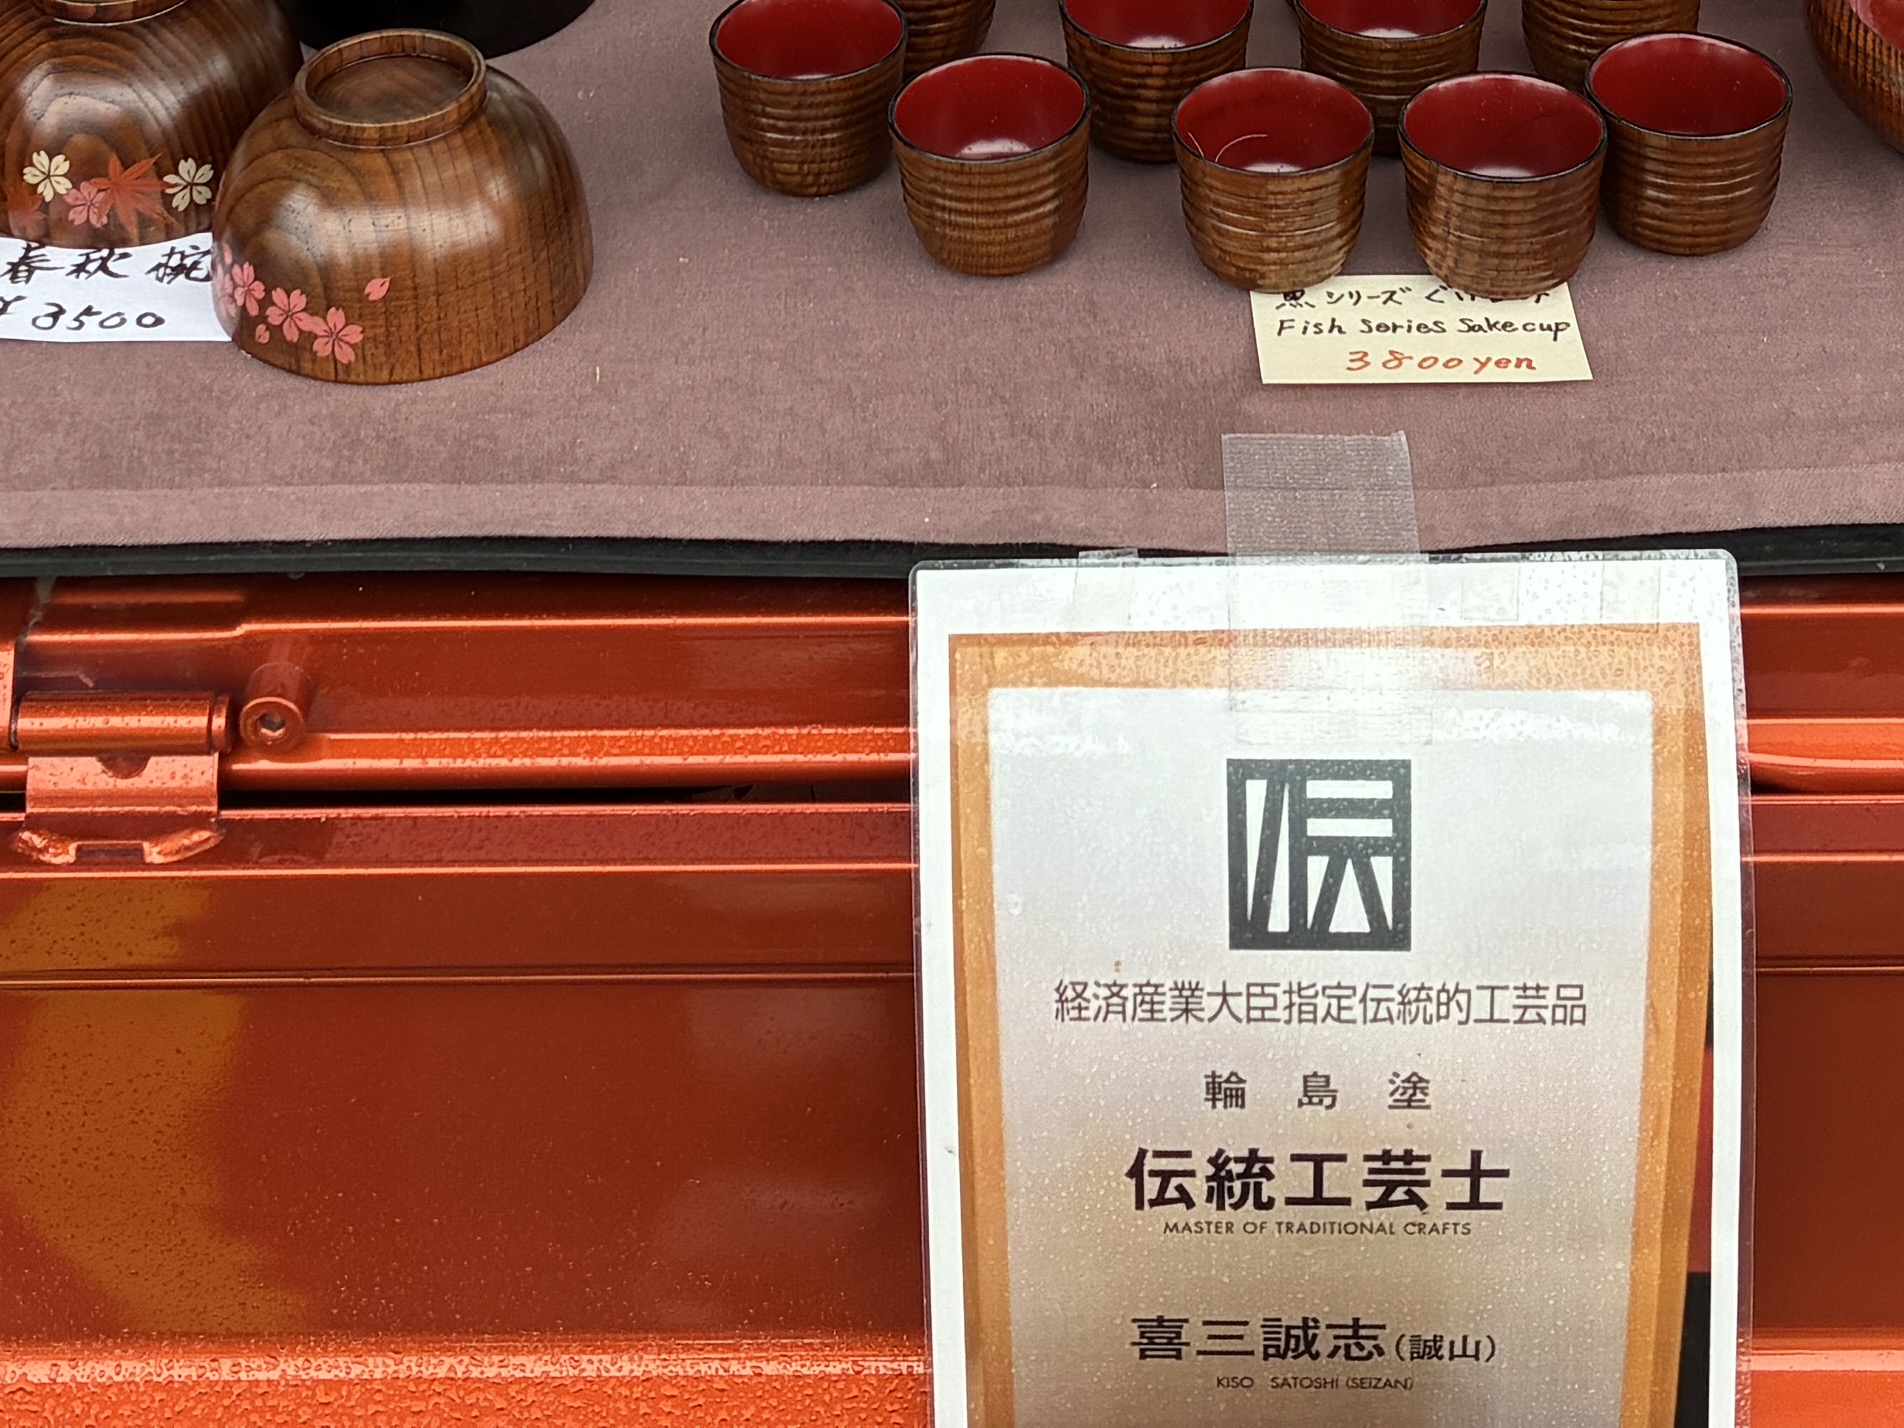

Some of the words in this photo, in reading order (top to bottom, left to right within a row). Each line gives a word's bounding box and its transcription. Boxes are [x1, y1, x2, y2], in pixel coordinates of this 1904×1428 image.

[1277, 318, 1346, 336] Fish
[1346, 350, 1463, 371] 3800
[1473, 355, 1536, 375] yen
[1054, 980, 1588, 1027] 経済産業大臣指定伝統的工芸品
[1124, 1145, 1510, 1213] 伝統工芸士
[1163, 1221, 1235, 1236] MASTER
[1243, 1221, 1267, 1235] OF
[1276, 1221, 1396, 1236] TRADITIONAL
[1403, 1221, 1472, 1236] CRAFTS
[1216, 1375, 1255, 1391] KISO
[1270, 1376, 1339, 1391] SATOSHI
